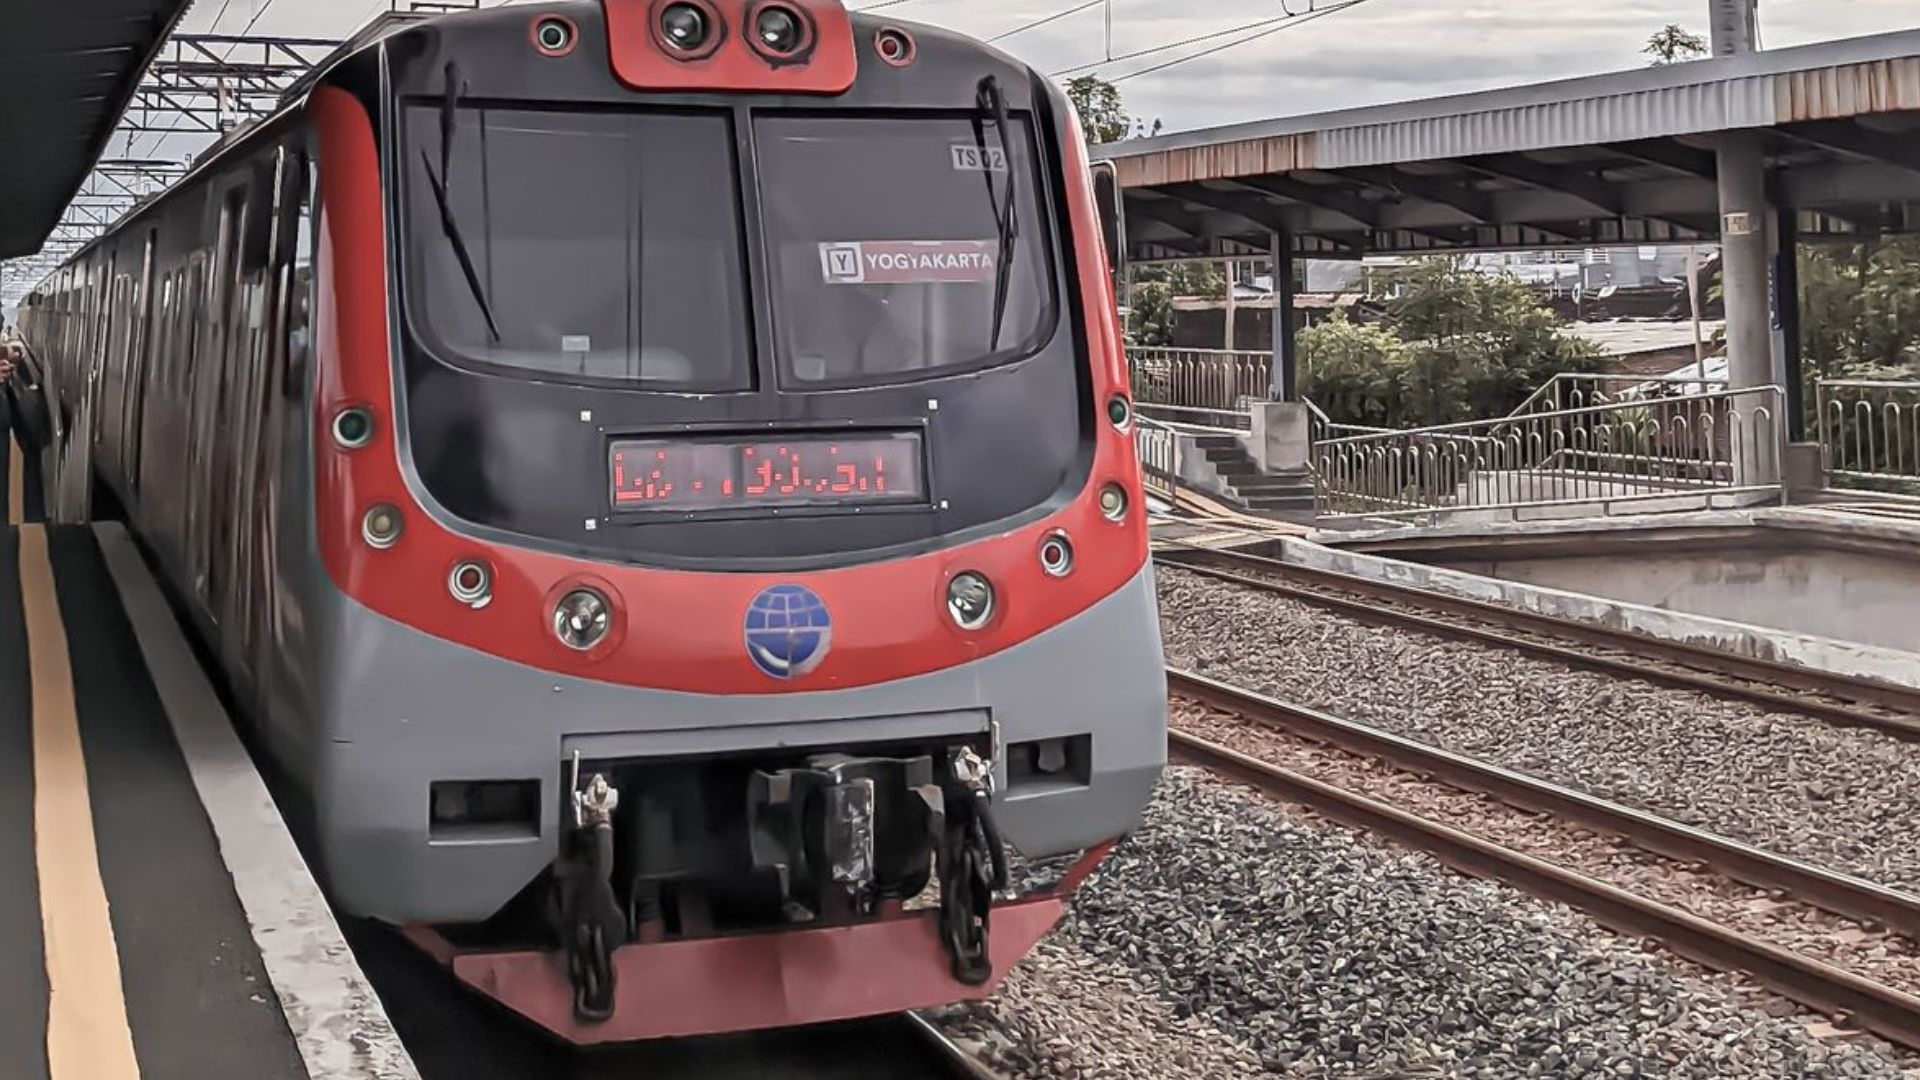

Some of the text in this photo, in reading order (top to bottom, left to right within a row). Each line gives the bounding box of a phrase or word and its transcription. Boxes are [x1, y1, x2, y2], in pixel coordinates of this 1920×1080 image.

[954, 148, 1003, 169] TS 02
[836, 254, 848, 271] Y
[866, 252, 993, 270] YOGYAKARTA
